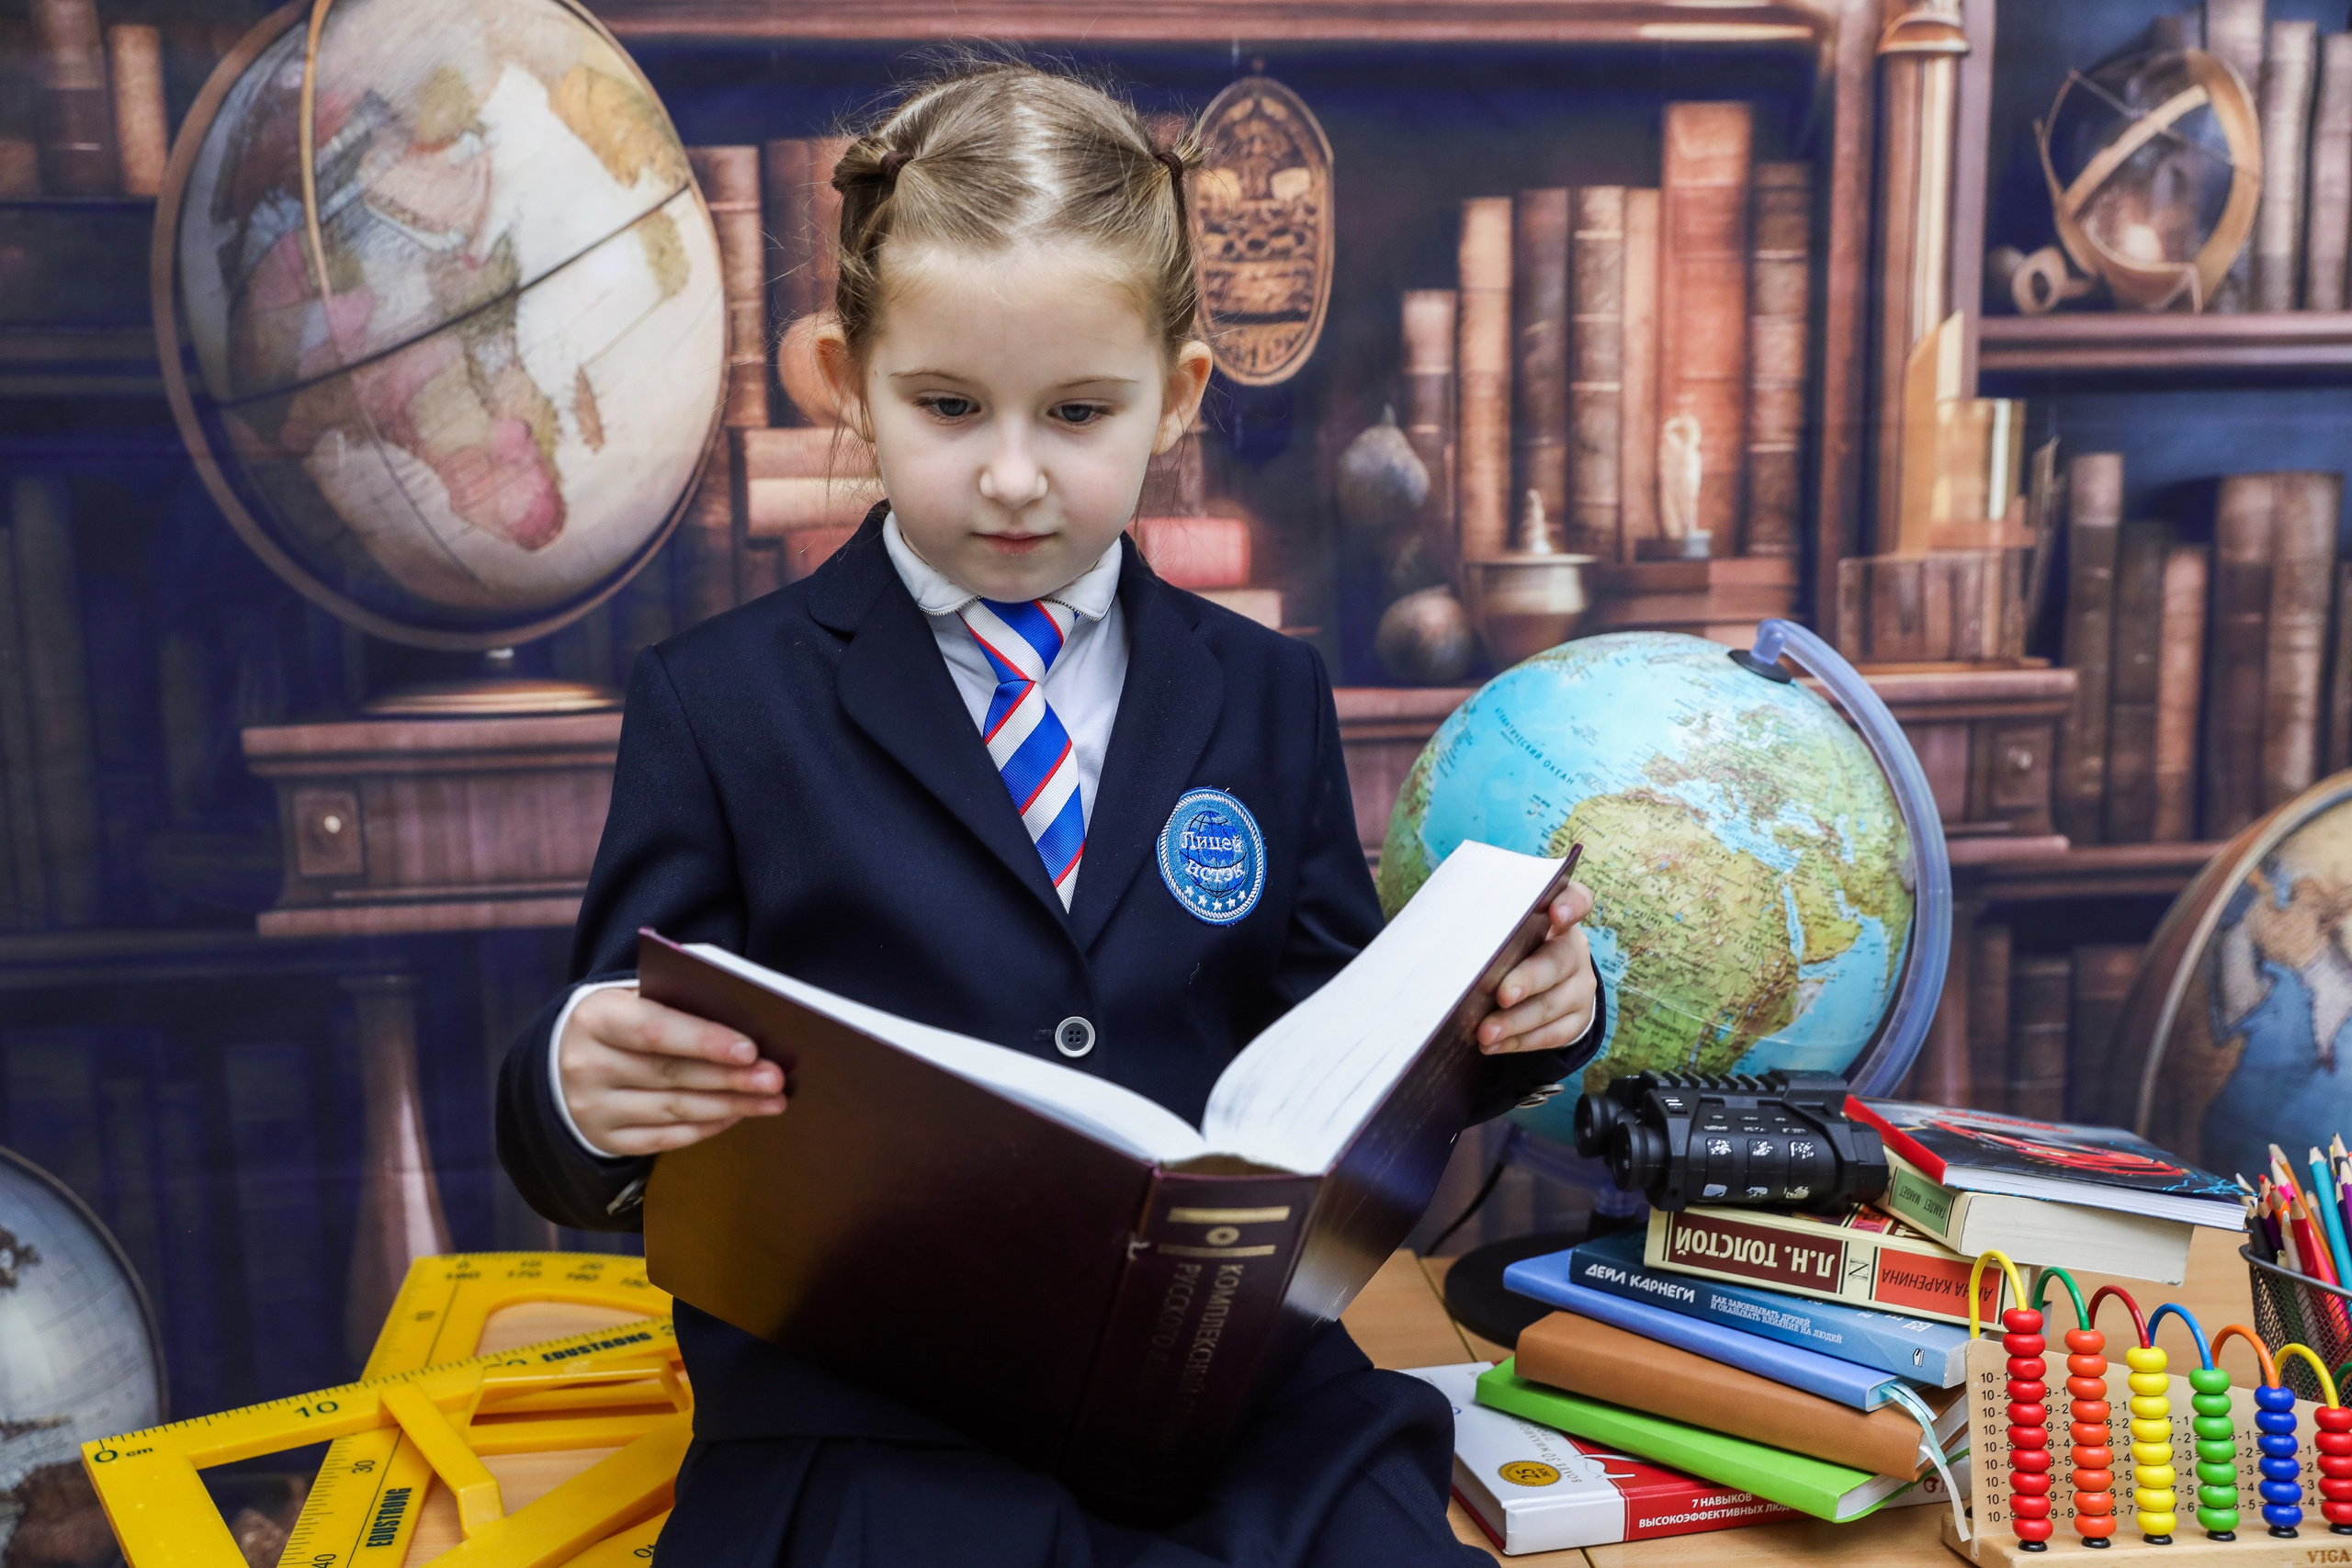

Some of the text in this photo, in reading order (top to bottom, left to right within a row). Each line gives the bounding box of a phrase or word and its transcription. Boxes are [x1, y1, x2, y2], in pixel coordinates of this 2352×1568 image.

[1180, 830, 1244, 853] Лицей
[1674, 1225, 1780, 1269] ТОЛСТОЙ
[1585, 1263, 1696, 1303] ДЕЙЛ КАРНЕГИ
[1882, 1268, 1953, 1294] КАРЕНИНА
[1151, 1263, 1203, 1348] РУССКОГО
[1710, 1294, 1812, 1327] КАК ЗАВОЕВЫВАТЬ ДРУЗЕЙ
[1717, 1303, 1761, 1322] ОКАЗЫВАТЬ
[1761, 1315, 1800, 1333] ВЛИЯНИЕ
[1800, 1325, 1813, 1336] НА
[1812, 1328, 1843, 1344] ЛЮДЕЙ
[540, 1332, 653, 1364] EDUSTRONG
[293, 1400, 339, 1418] 10
[94, 1447, 153, 1463] 0 cm
[351, 1459, 376, 1474] 30
[1515, 1468, 1542, 1481] 25
[1691, 1493, 1753, 1509] 7 НАВЫКОВ
[366, 1487, 413, 1548] EDUSTRONG
[1638, 1502, 1795, 1529] ВЫСОКОЭФФЕКТИВНЫХ ЛЮД
[2306, 1549, 2351, 1563] VIGA
